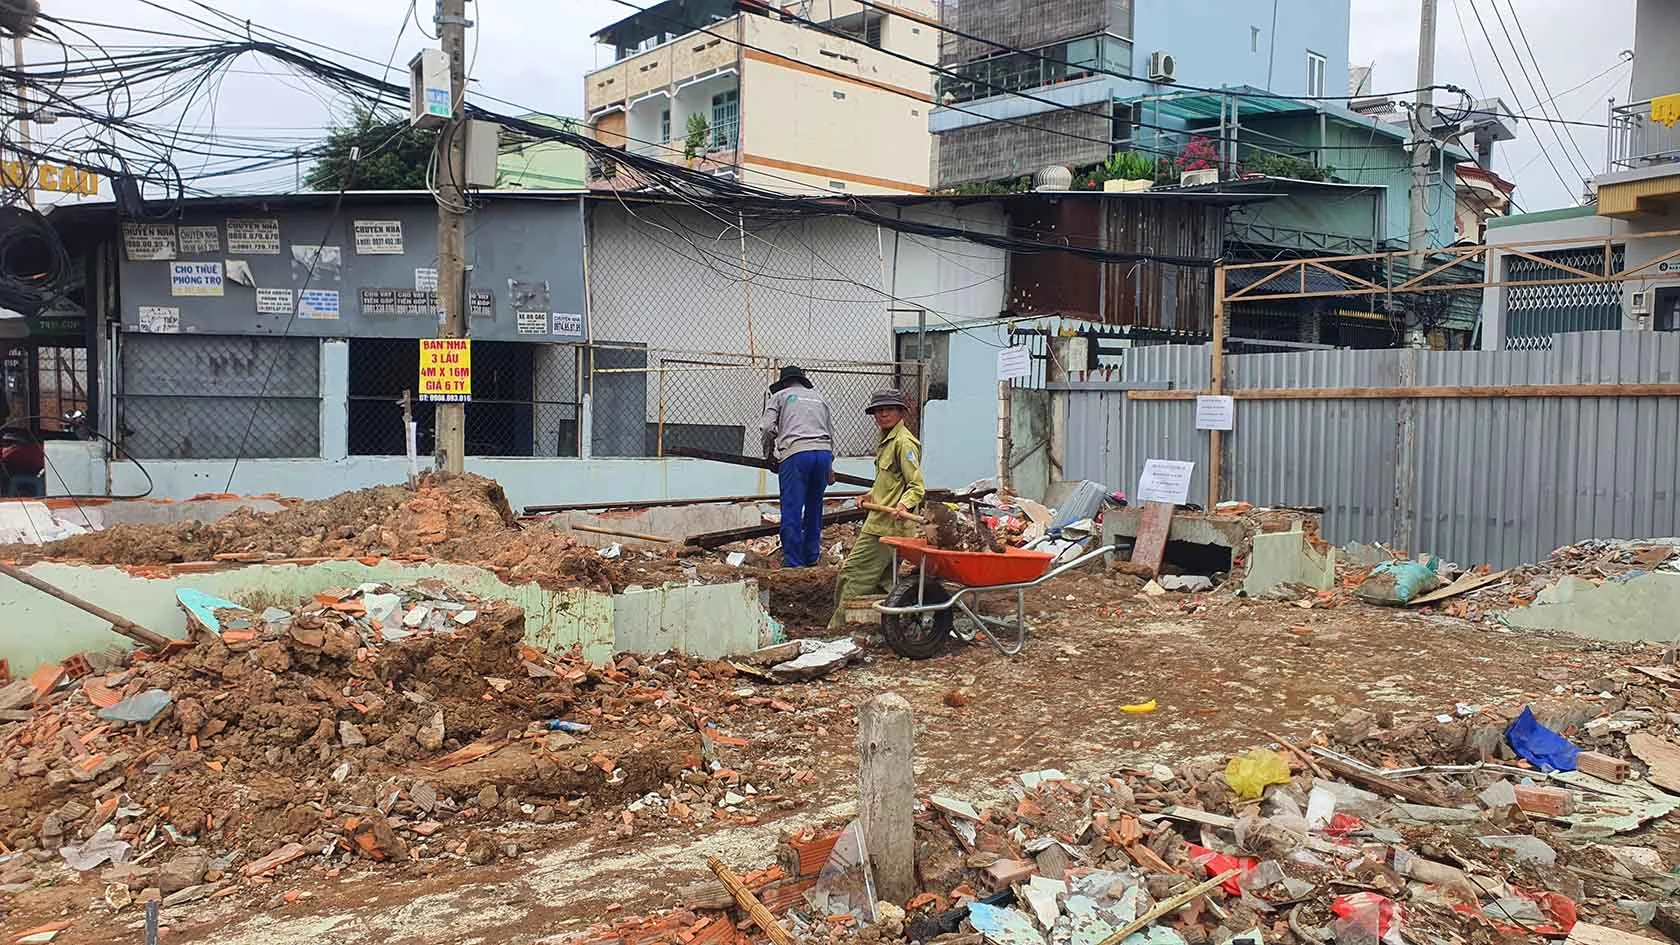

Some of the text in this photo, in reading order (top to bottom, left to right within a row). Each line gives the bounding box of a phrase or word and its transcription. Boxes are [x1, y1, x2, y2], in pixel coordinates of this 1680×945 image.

[196, 263, 217, 273] THUÊ
[173, 275, 222, 285] PHÒNG TRỌ
[431, 353, 438, 363] 3
[421, 367, 470, 377] 4M X 16M
[444, 380, 451, 391] 6
